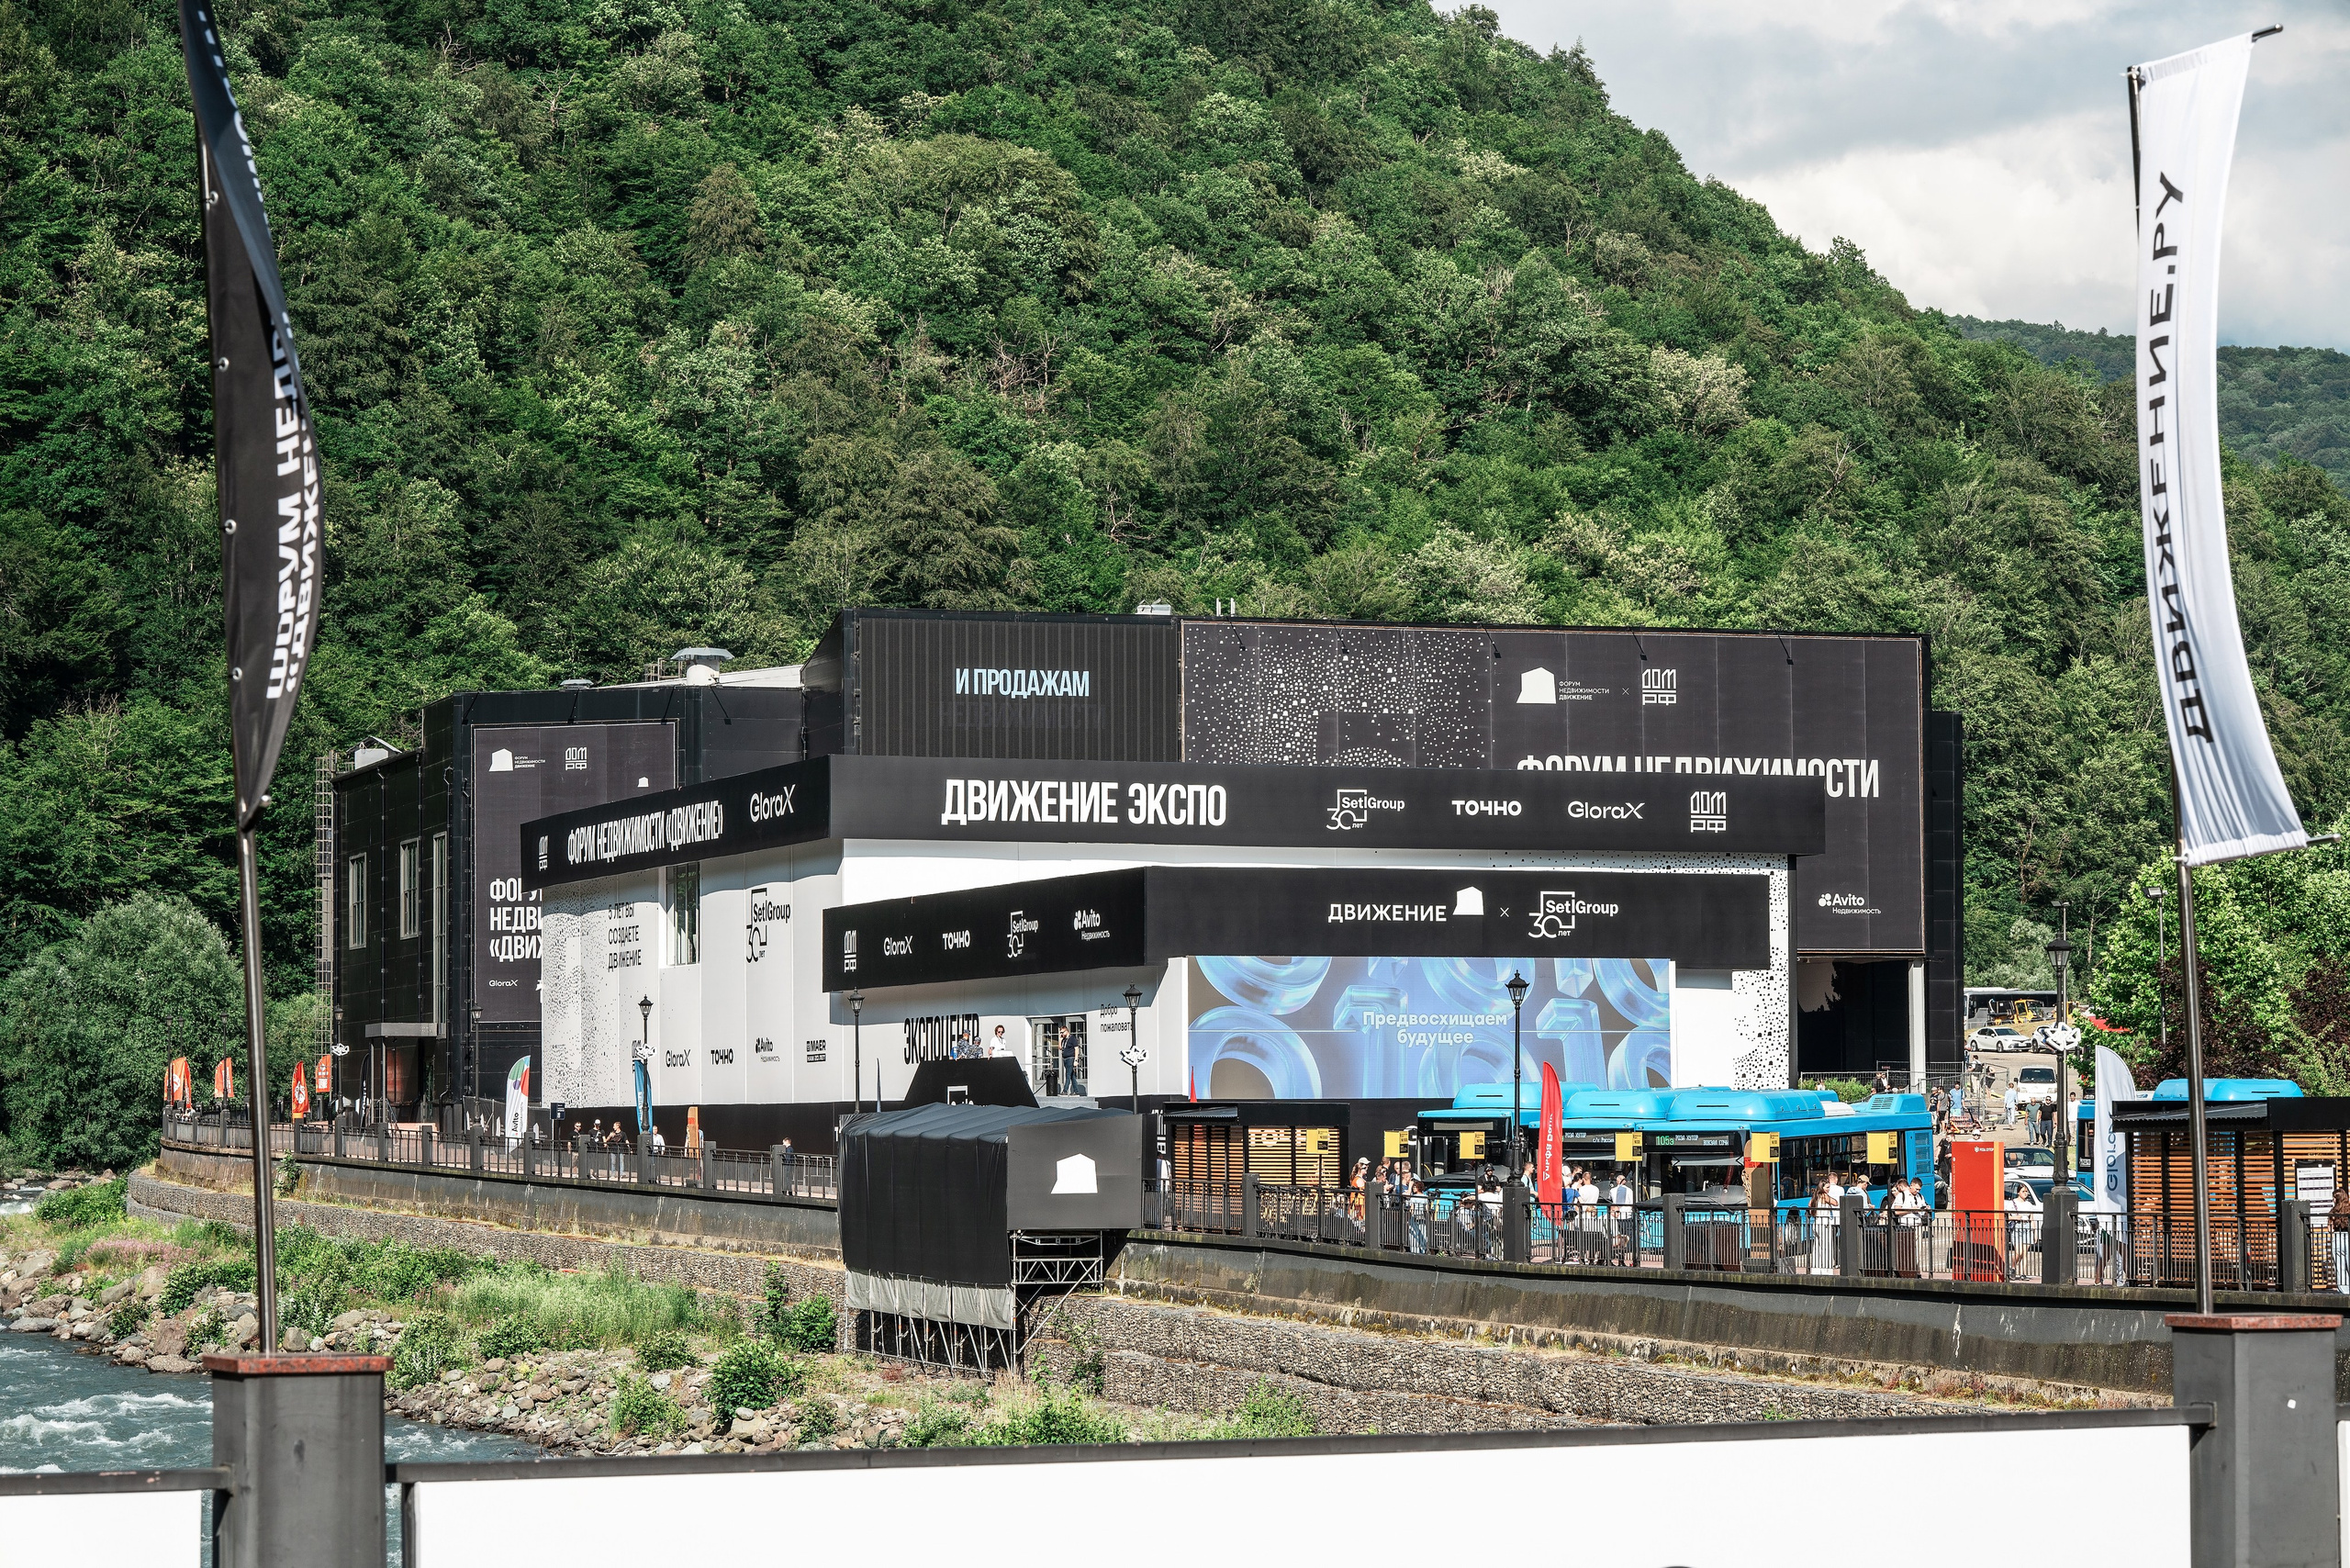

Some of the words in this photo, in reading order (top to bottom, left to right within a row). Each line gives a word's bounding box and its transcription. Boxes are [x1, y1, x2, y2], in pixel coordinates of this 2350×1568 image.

[2148, 172, 2214, 744] ДВИЖЕНИЕ.РУ
[956, 668, 969, 695] И
[973, 668, 1090, 700] ПРОДАЖАМ
[1641, 668, 1677, 689] ДОМ
[1642, 693, 1677, 706] РФ
[565, 746, 588, 760] ДОМ
[565, 762, 588, 771] РФ
[749, 784, 797, 823] GloraX
[941, 778, 1119, 826] ДВИЖЕНИЕ
[1126, 782, 1227, 826] ЭКСПО
[1451, 799, 1523, 817] ТОЧНО
[1567, 801, 1646, 822] GloraX
[1690, 790, 1727, 814] ДОМ
[567, 826, 597, 866] ФОРУМ
[596, 810, 666, 864] НЕДВИЖИМОСТИ
[666, 799, 723, 852] «ДВИЖЕНИЕ»
[1351, 822, 1364, 830] лет
[1690, 820, 1727, 834] РФ
[1831, 893, 1865, 906] Avito
[608, 906, 613, 920] 5
[613, 904, 624, 920] ЛЕТ
[624, 902, 635, 918] ВЫ
[1081, 909, 1101, 928] Avito
[1327, 903, 1447, 923] ДВИЖЕНИЕ
[1832, 907, 1882, 915] Недвижимость
[608, 924, 640, 947] СОЗДАЕТЕ
[844, 930, 857, 954] ДОМ
[942, 929, 971, 950] ТОЧНО
[1081, 930, 1111, 941] Недвижимость
[1557, 928, 1572, 937] лет
[883, 935, 912, 957] GloraX
[608, 949, 642, 972] ДВИЖЕНИЕ
[844, 958, 857, 973] РФ
[488, 979, 519, 987] GloraX
[1100, 1003, 1118, 1018] Добро
[1362, 1011, 1507, 1029] Предвосхищаем
[760, 1037, 774, 1052] Avito
[1397, 1029, 1474, 1048] будущее
[666, 1049, 691, 1069] GloraX
[711, 1048, 734, 1066] ТОЧНО
[511, 1113, 520, 1132] Avito
